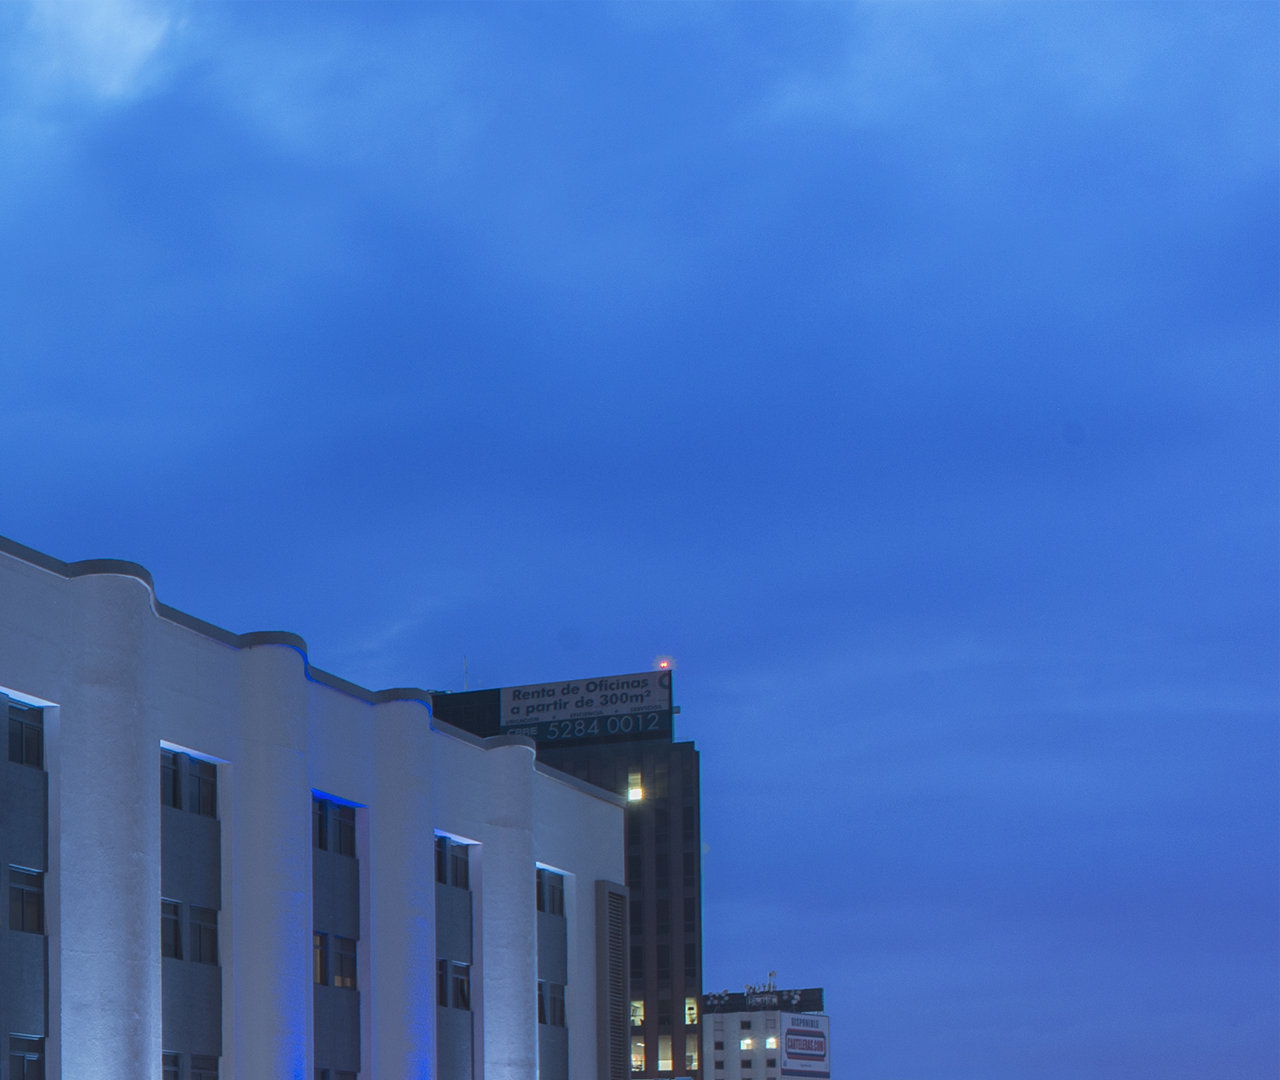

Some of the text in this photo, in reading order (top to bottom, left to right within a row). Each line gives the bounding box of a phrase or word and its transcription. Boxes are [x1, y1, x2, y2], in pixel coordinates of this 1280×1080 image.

[512, 678, 649, 701] Renta de Oficinas
[511, 706, 521, 715] a
[526, 698, 569, 716] partir
[575, 696, 594, 708] de
[547, 718, 599, 740] 5284
[607, 713, 660, 734] 0012
